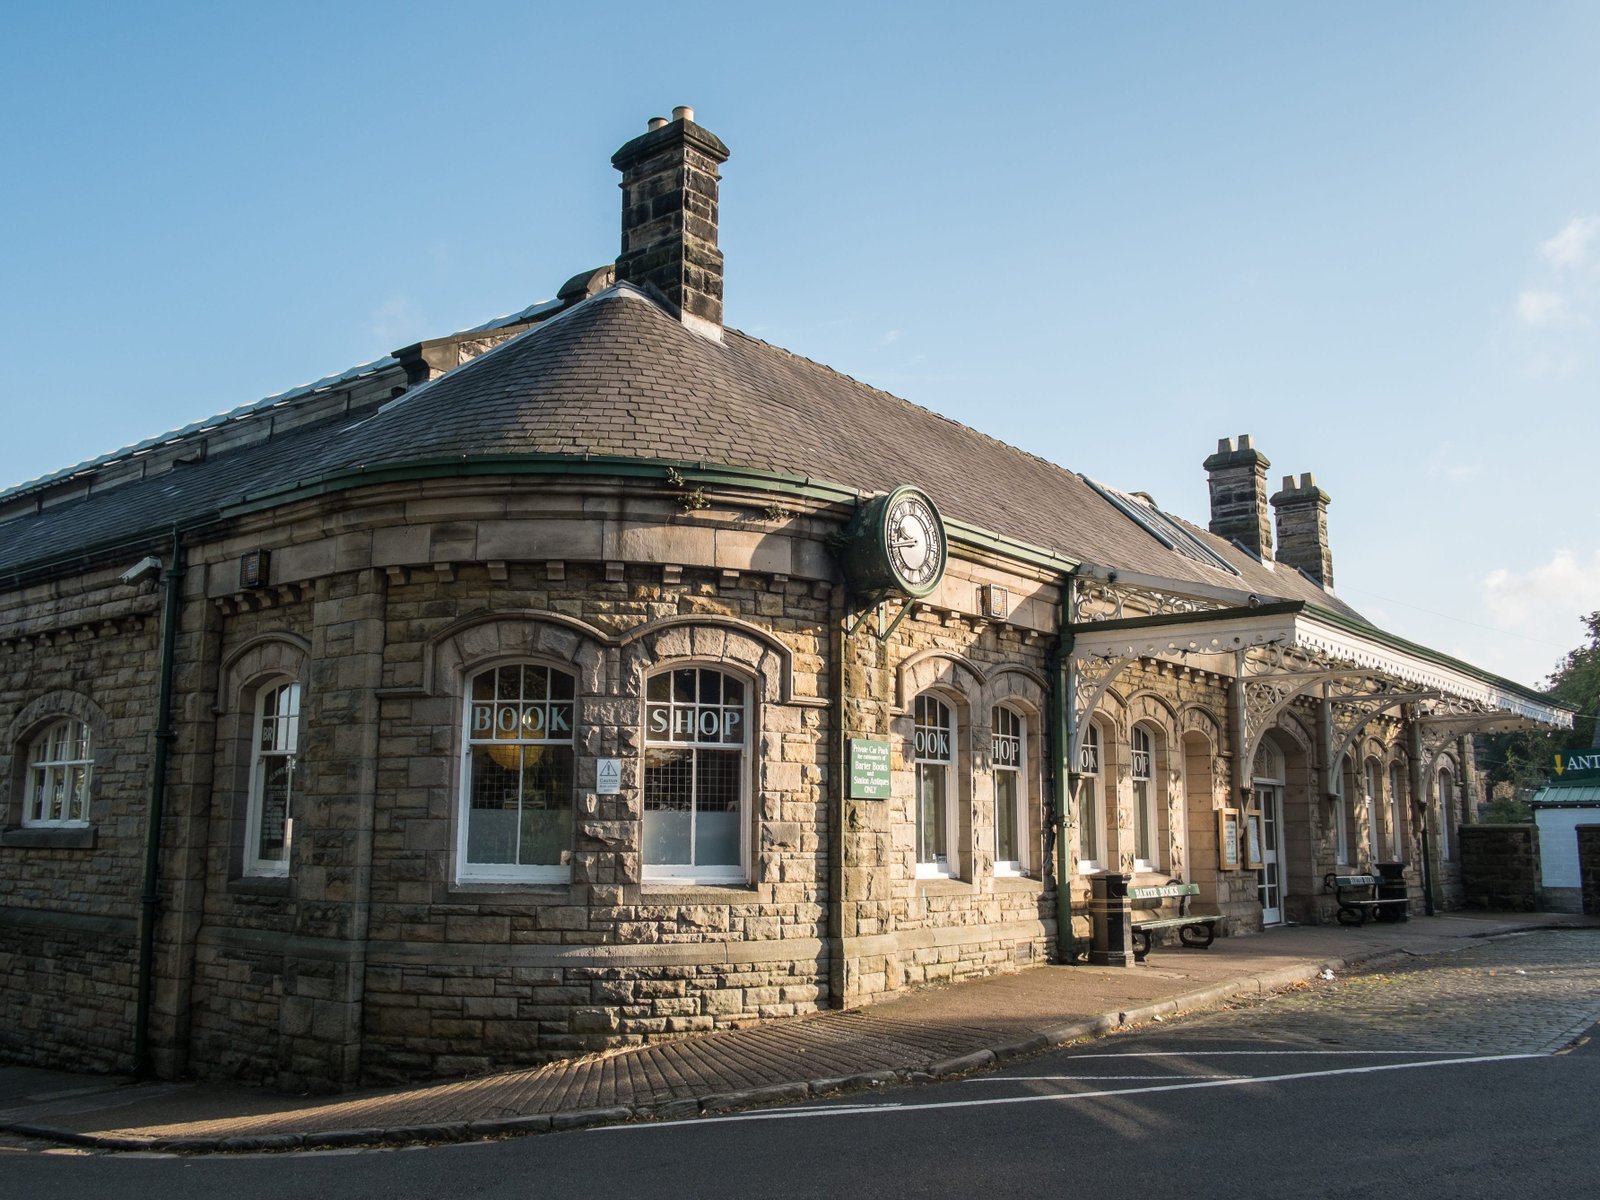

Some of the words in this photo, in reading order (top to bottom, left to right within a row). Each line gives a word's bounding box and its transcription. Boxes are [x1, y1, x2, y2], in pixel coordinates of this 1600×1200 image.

[472, 706, 570, 732] BOOK
[650, 708, 740, 735] SHOP
[853, 744, 868, 753] Private
[869, 745, 877, 753] Car
[878, 746, 888, 755] Park
[915, 731, 949, 754] OOK
[992, 739, 1019, 760] HOP
[855, 761, 871, 770] Barter
[872, 762, 888, 772] Books
[1081, 749, 1097, 768] OK
[1134, 755, 1149, 773] OP
[854, 776, 869, 784] Station
[870, 777, 889, 787] Antiques
[864, 786, 877, 794] ONLY
[1135, 887, 1158, 899] BARTER
[1159, 886, 1179, 896] BOOKS
